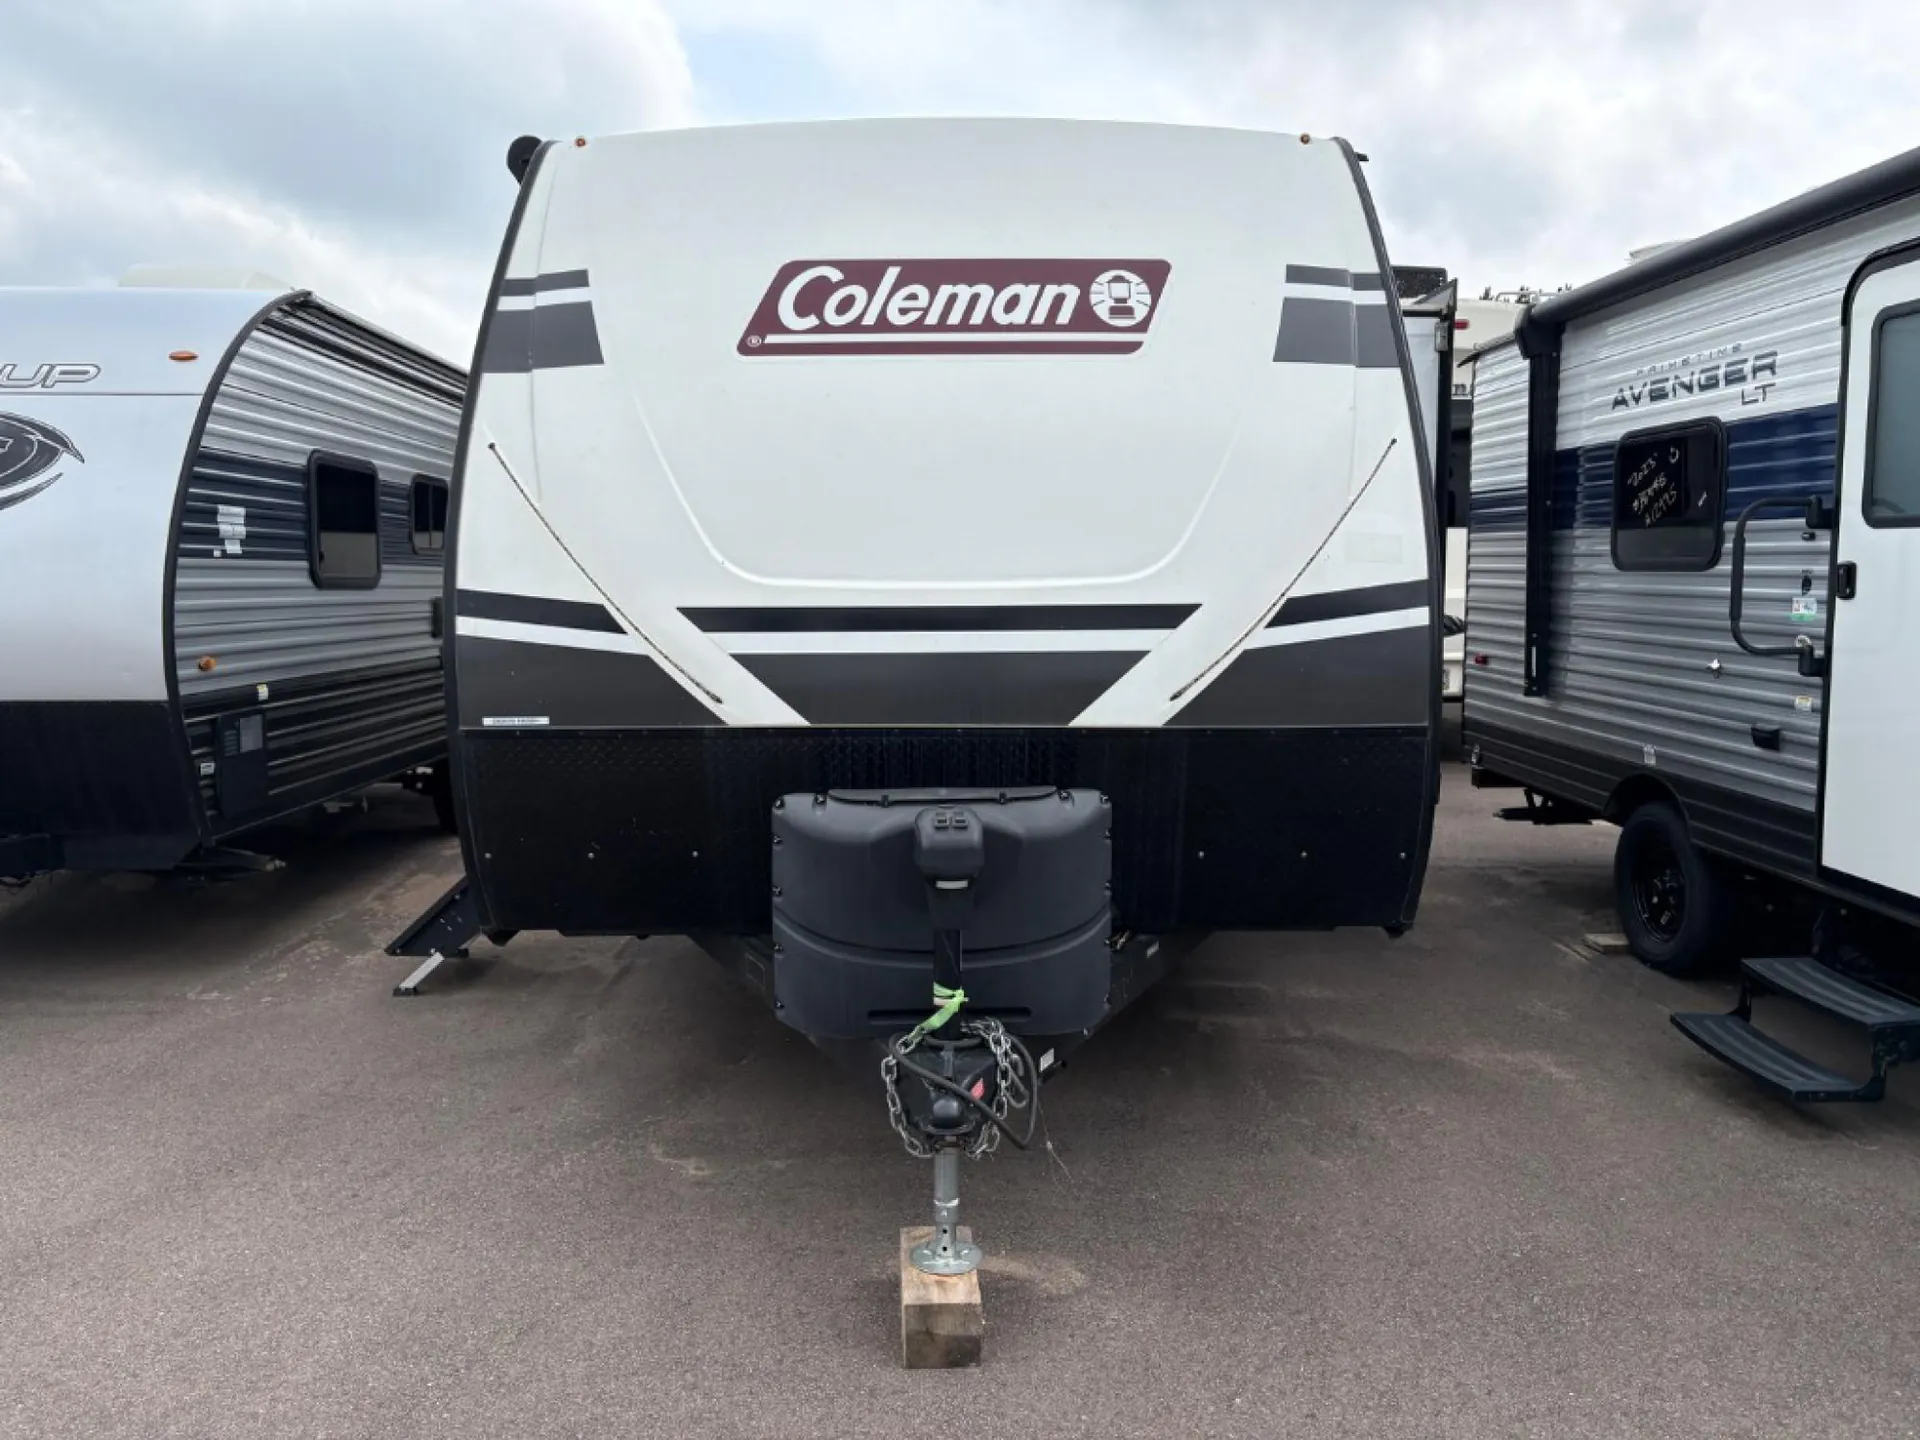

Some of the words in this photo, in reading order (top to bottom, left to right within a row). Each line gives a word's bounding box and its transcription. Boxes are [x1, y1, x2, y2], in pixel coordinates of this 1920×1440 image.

[777, 265, 1081, 331] Coleman
[1612, 350, 1778, 410] AVENGER
[1741, 382, 1776, 405] LT
